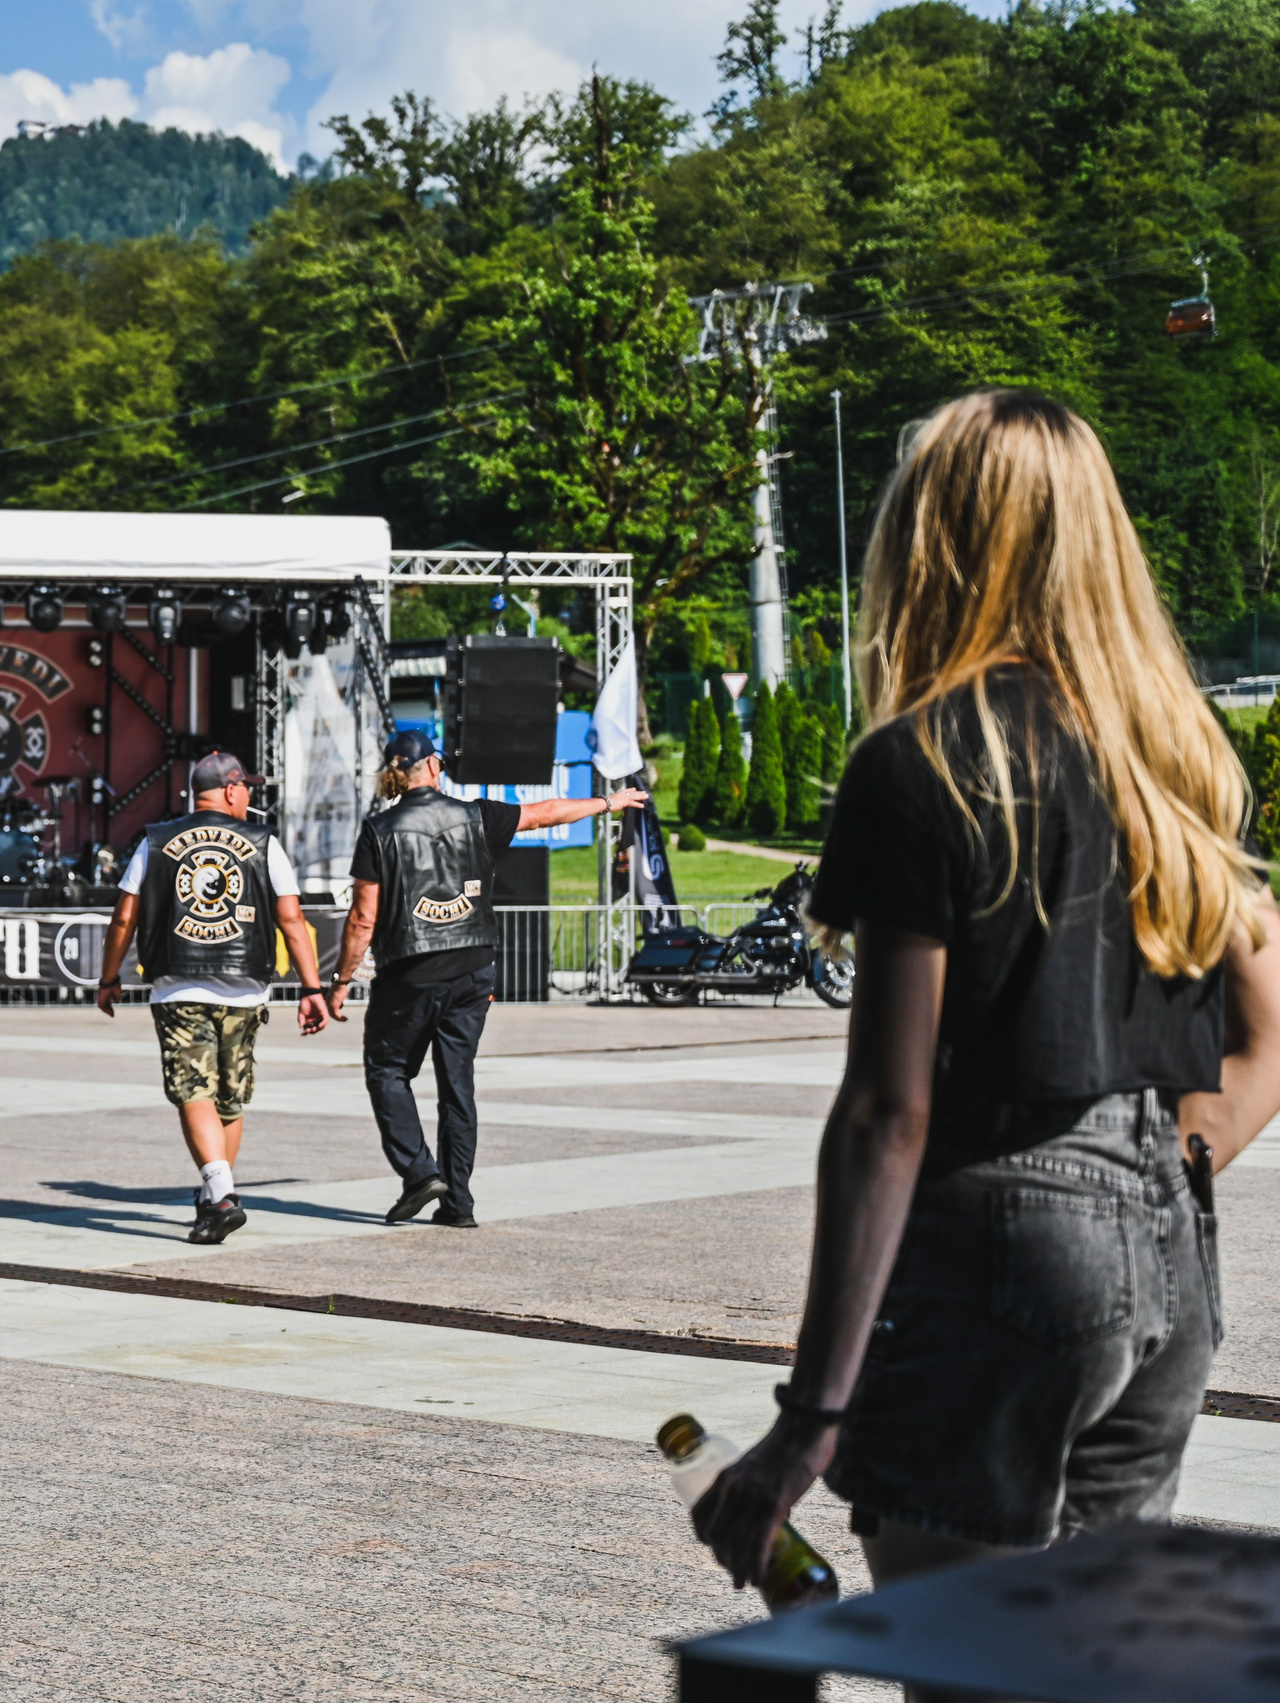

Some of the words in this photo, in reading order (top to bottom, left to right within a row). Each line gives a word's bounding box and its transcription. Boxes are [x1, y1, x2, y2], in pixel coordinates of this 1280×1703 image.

[169, 829, 251, 857] MEDVEDI
[420, 899, 468, 919] SOCHI
[182, 920, 236, 940] SOCHI
